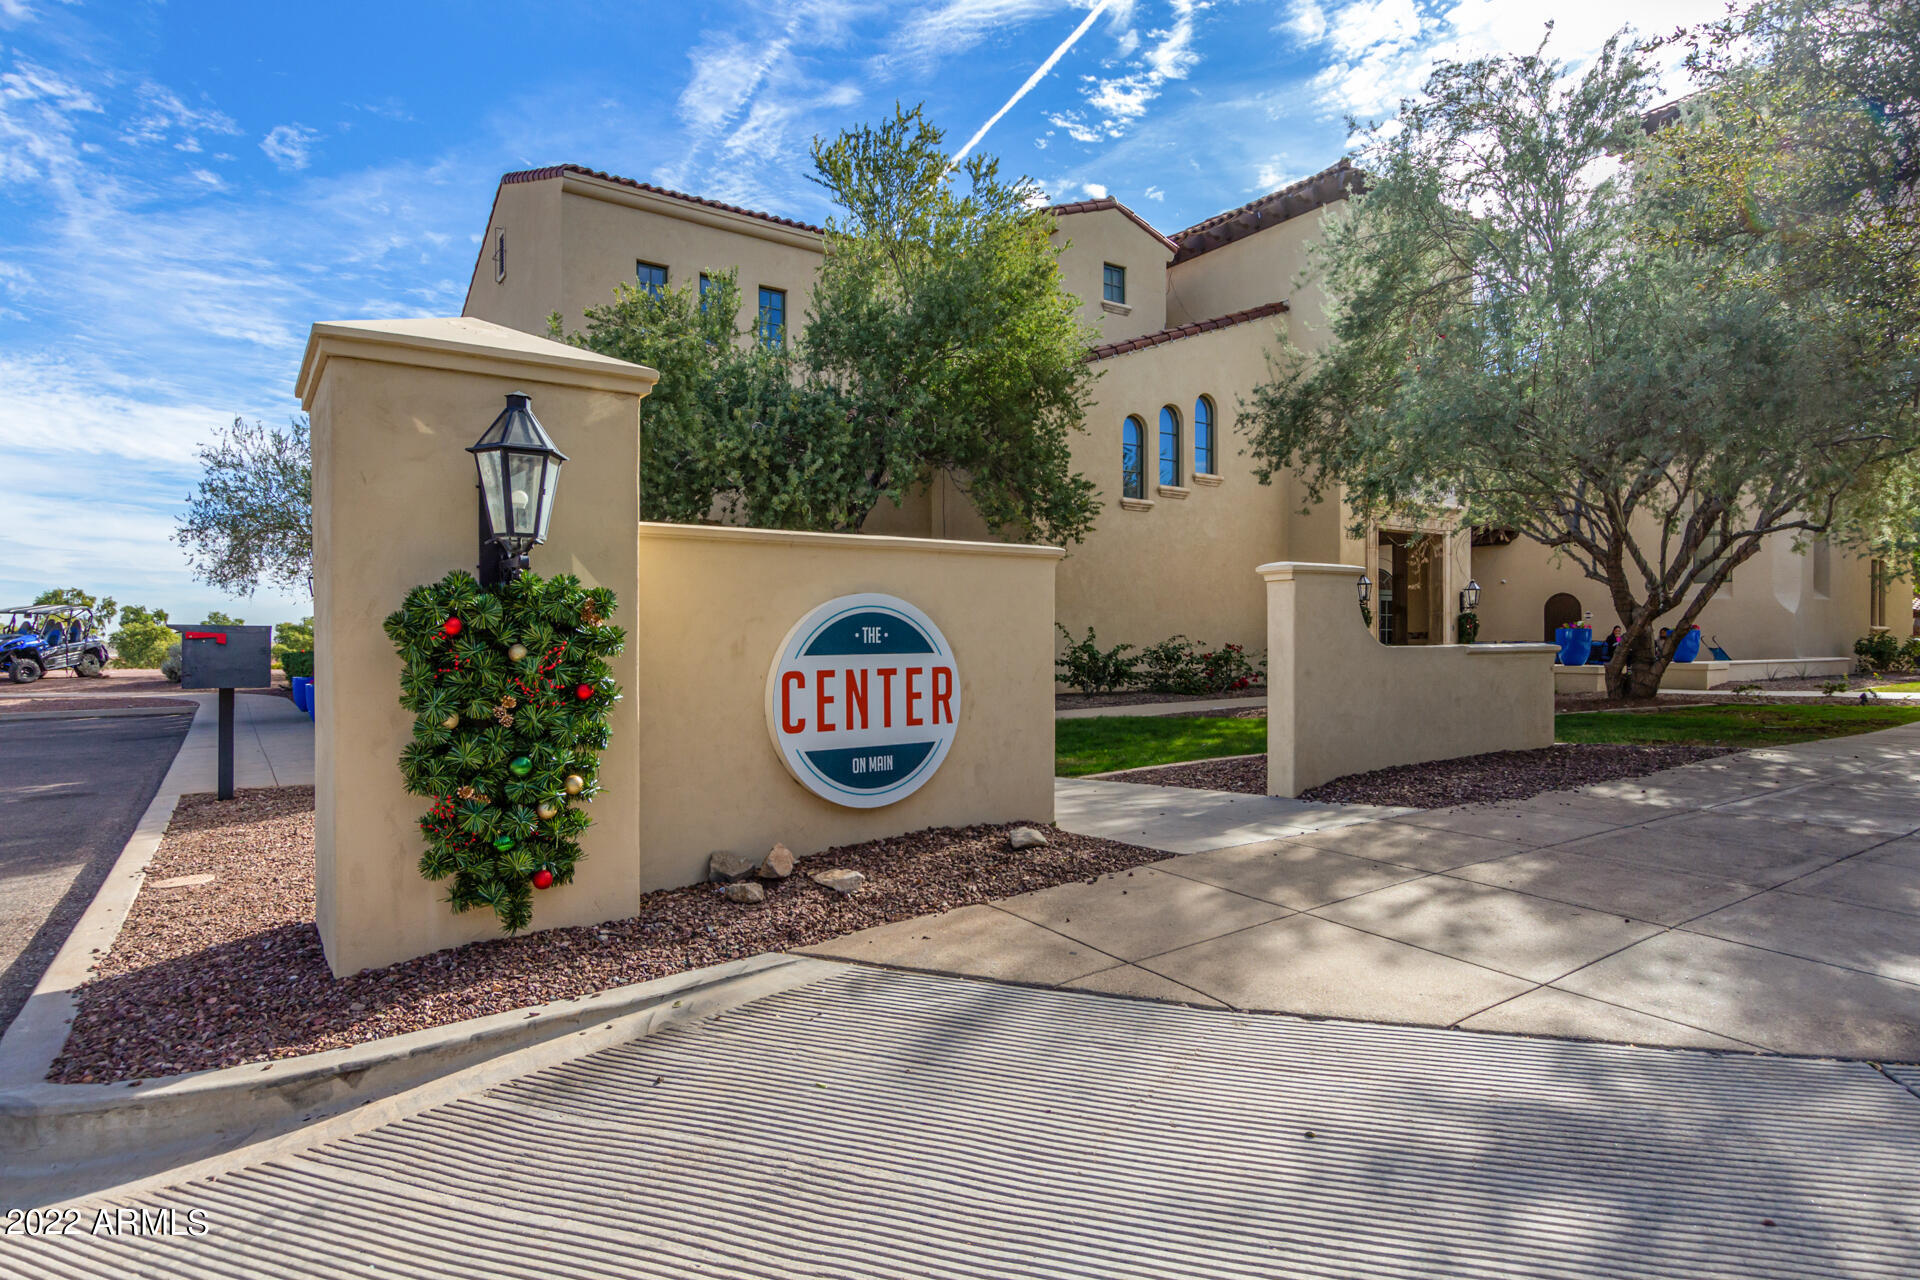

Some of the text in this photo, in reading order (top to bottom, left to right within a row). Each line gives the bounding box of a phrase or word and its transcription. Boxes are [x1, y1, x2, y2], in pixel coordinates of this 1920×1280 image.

[862, 626, 882, 644] THE
[781, 666, 953, 735] CENTER
[852, 755, 894, 774] ON MAIN
